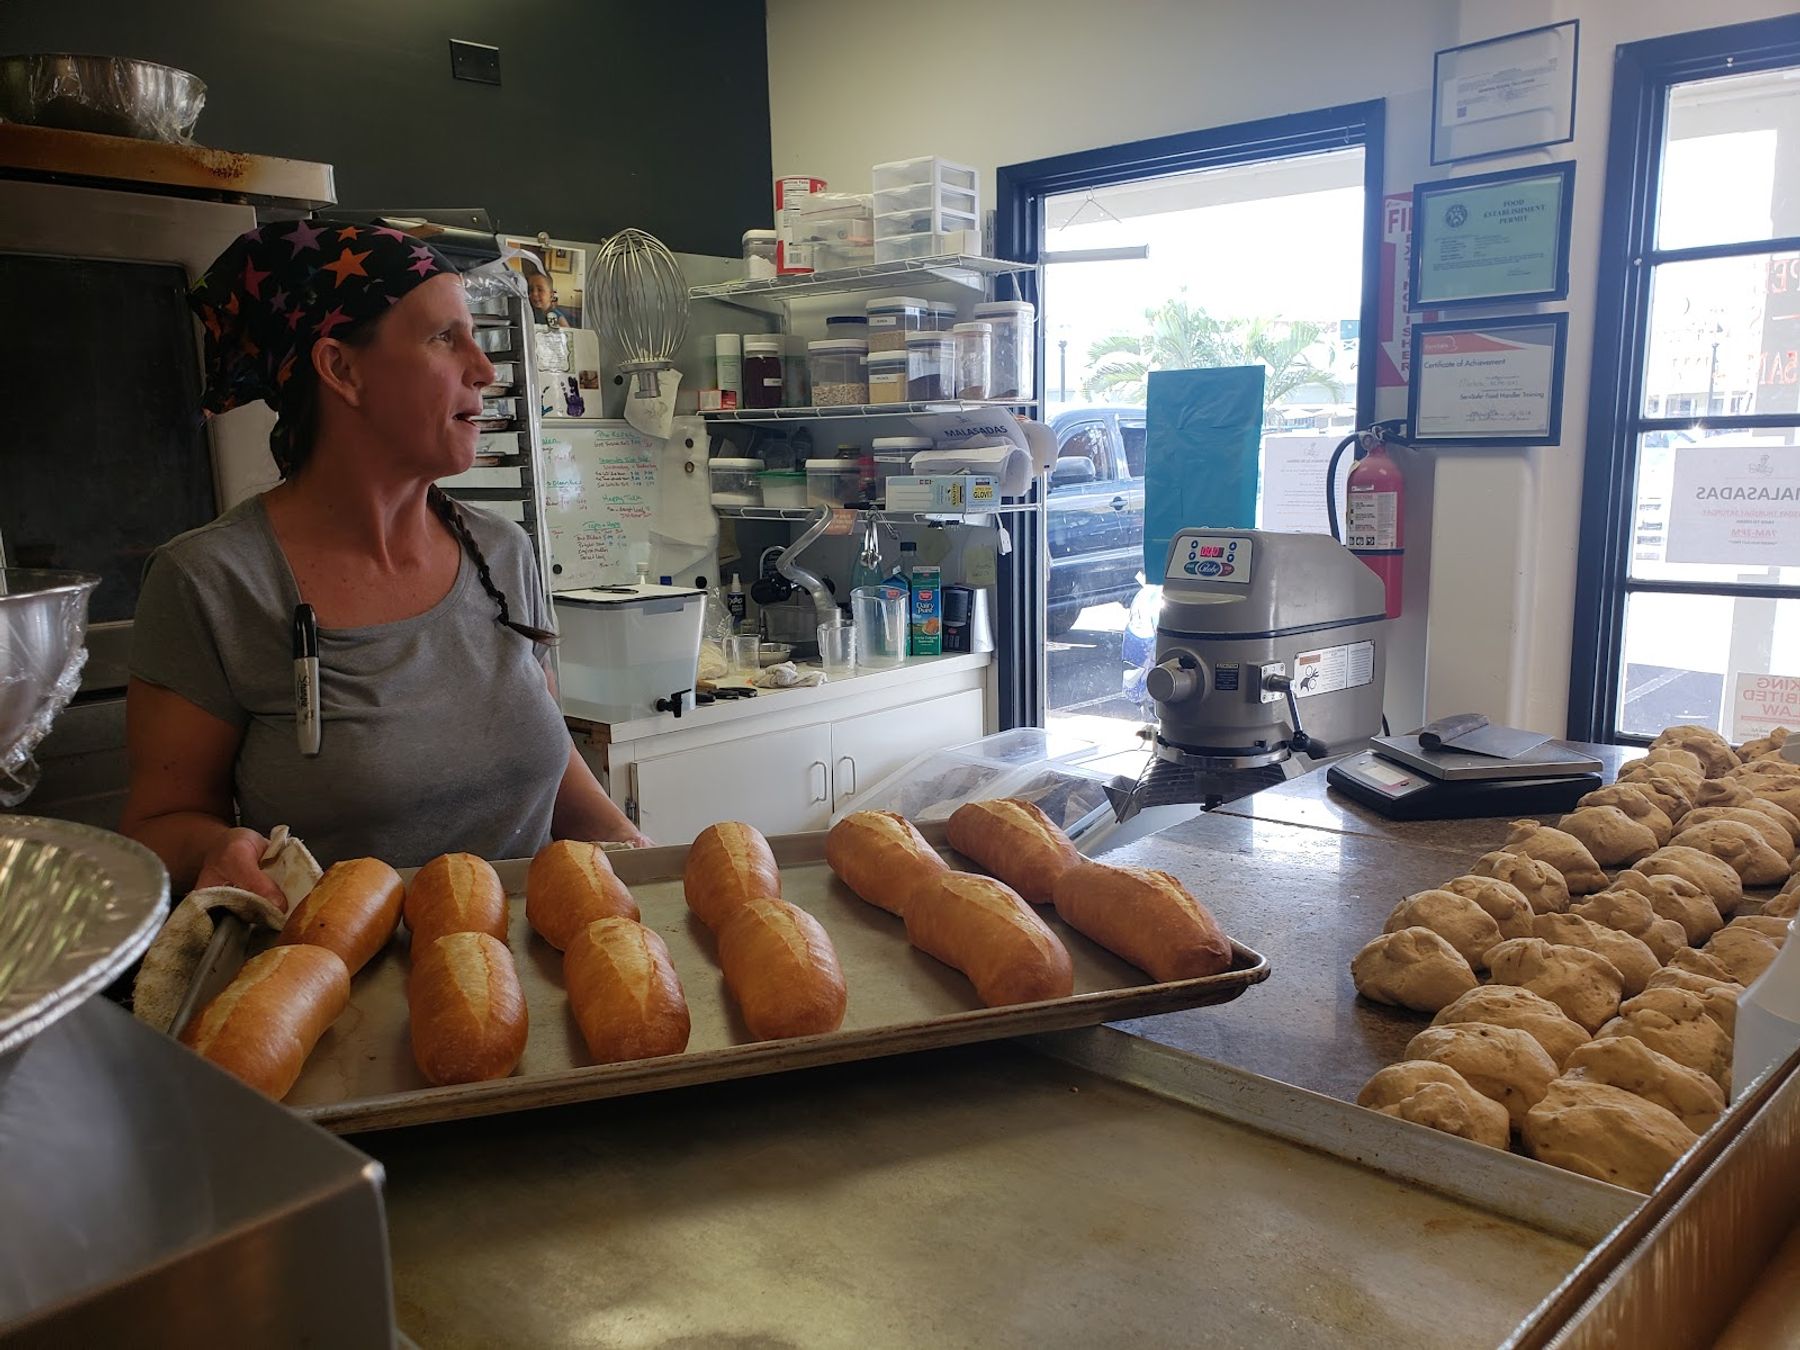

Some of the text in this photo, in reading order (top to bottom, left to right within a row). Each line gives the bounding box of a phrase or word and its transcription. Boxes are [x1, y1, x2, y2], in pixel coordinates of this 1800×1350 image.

[1504, 199, 1525, 208] FOOD
[1484, 204, 1545, 218] ESTABLISHMENT
[1388, 207, 1412, 234] FI
[1500, 215, 1528, 224] PERMIT
[1424, 358, 1506, 369] Certificate of Achievement
[944, 426, 1008, 437] MALASADAS
[916, 602, 935, 610] Dairy
